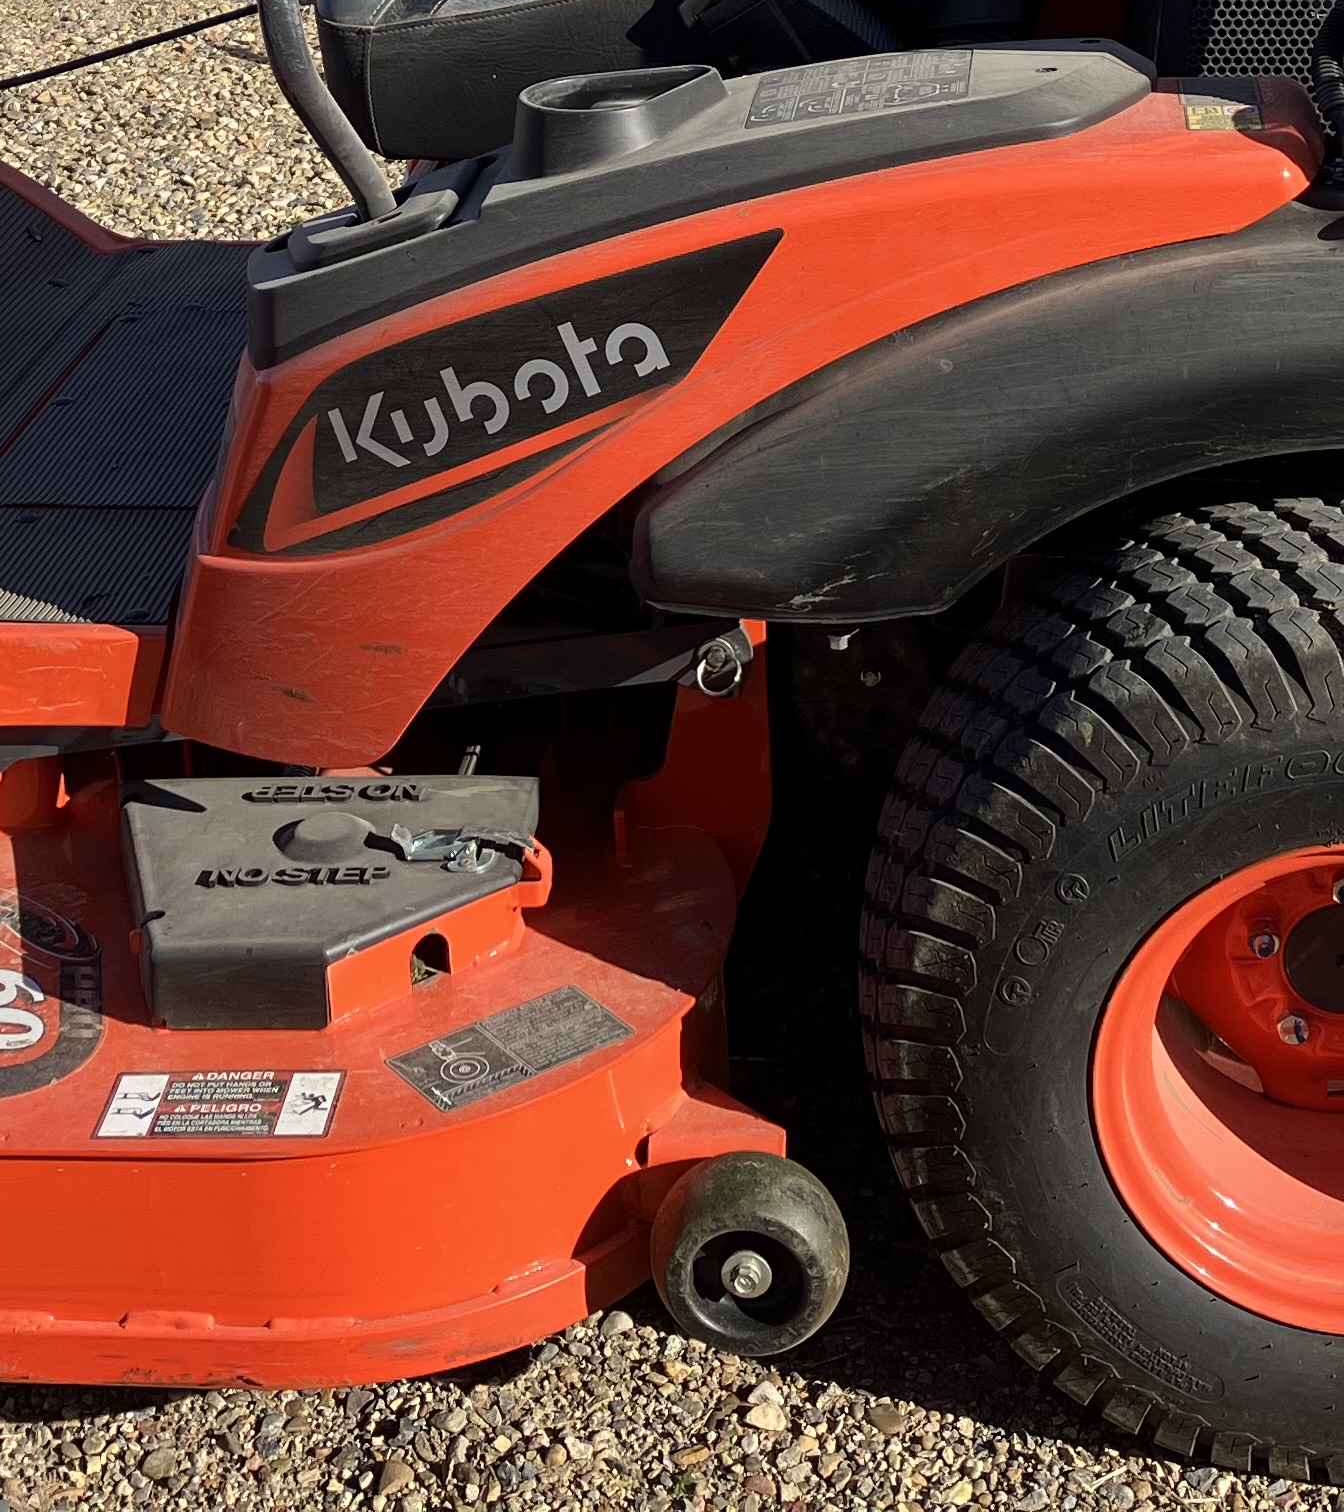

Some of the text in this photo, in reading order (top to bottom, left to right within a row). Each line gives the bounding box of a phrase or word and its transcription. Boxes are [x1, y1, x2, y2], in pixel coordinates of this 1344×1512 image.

[327, 321, 671, 469] Kubota
[242, 782, 426, 804] NO STEP
[196, 866, 392, 888] NO STEP
[206, 1071, 275, 1081] DANGER
[252, 1086, 280, 1094] WHEN
[189, 1103, 263, 1113] PELIGRO
